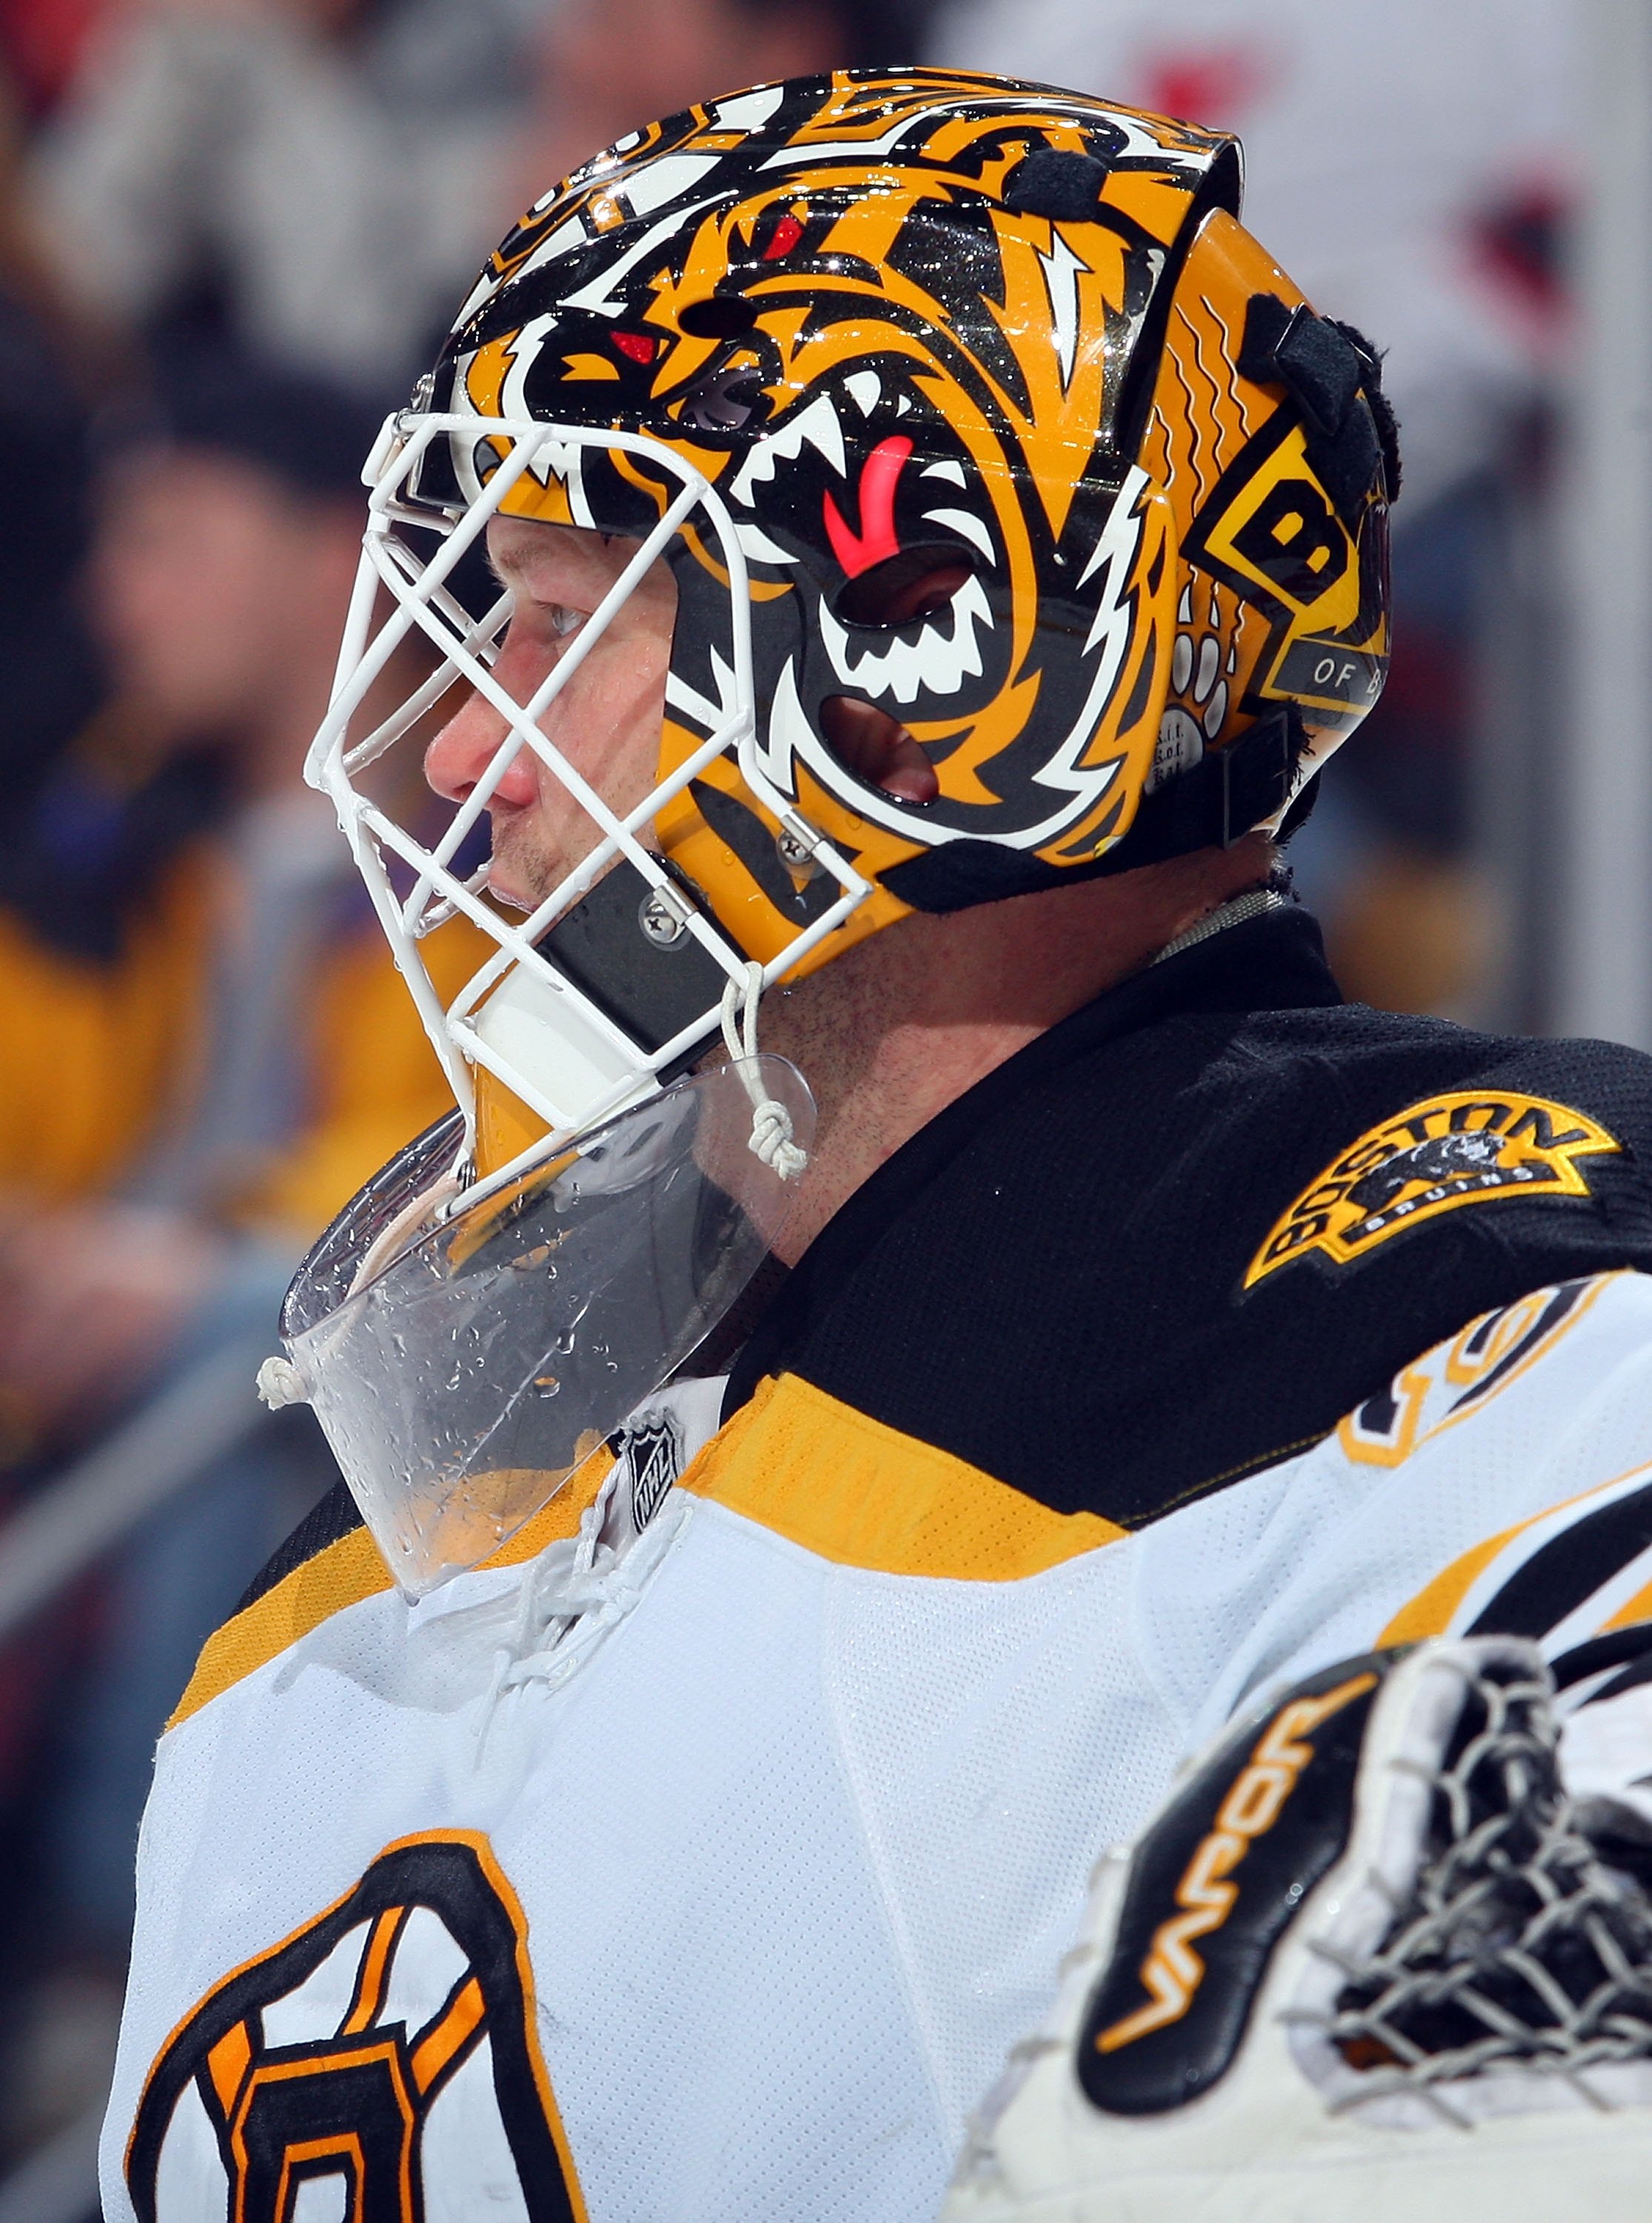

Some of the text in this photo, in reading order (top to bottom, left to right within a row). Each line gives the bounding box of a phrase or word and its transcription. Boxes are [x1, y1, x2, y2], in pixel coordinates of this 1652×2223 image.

[1230, 479, 1348, 607] B
[1314, 657, 1357, 688] OF
[1262, 1103, 1591, 1266] BOSTON
[1096, 1670, 1380, 2055] VAPOR
